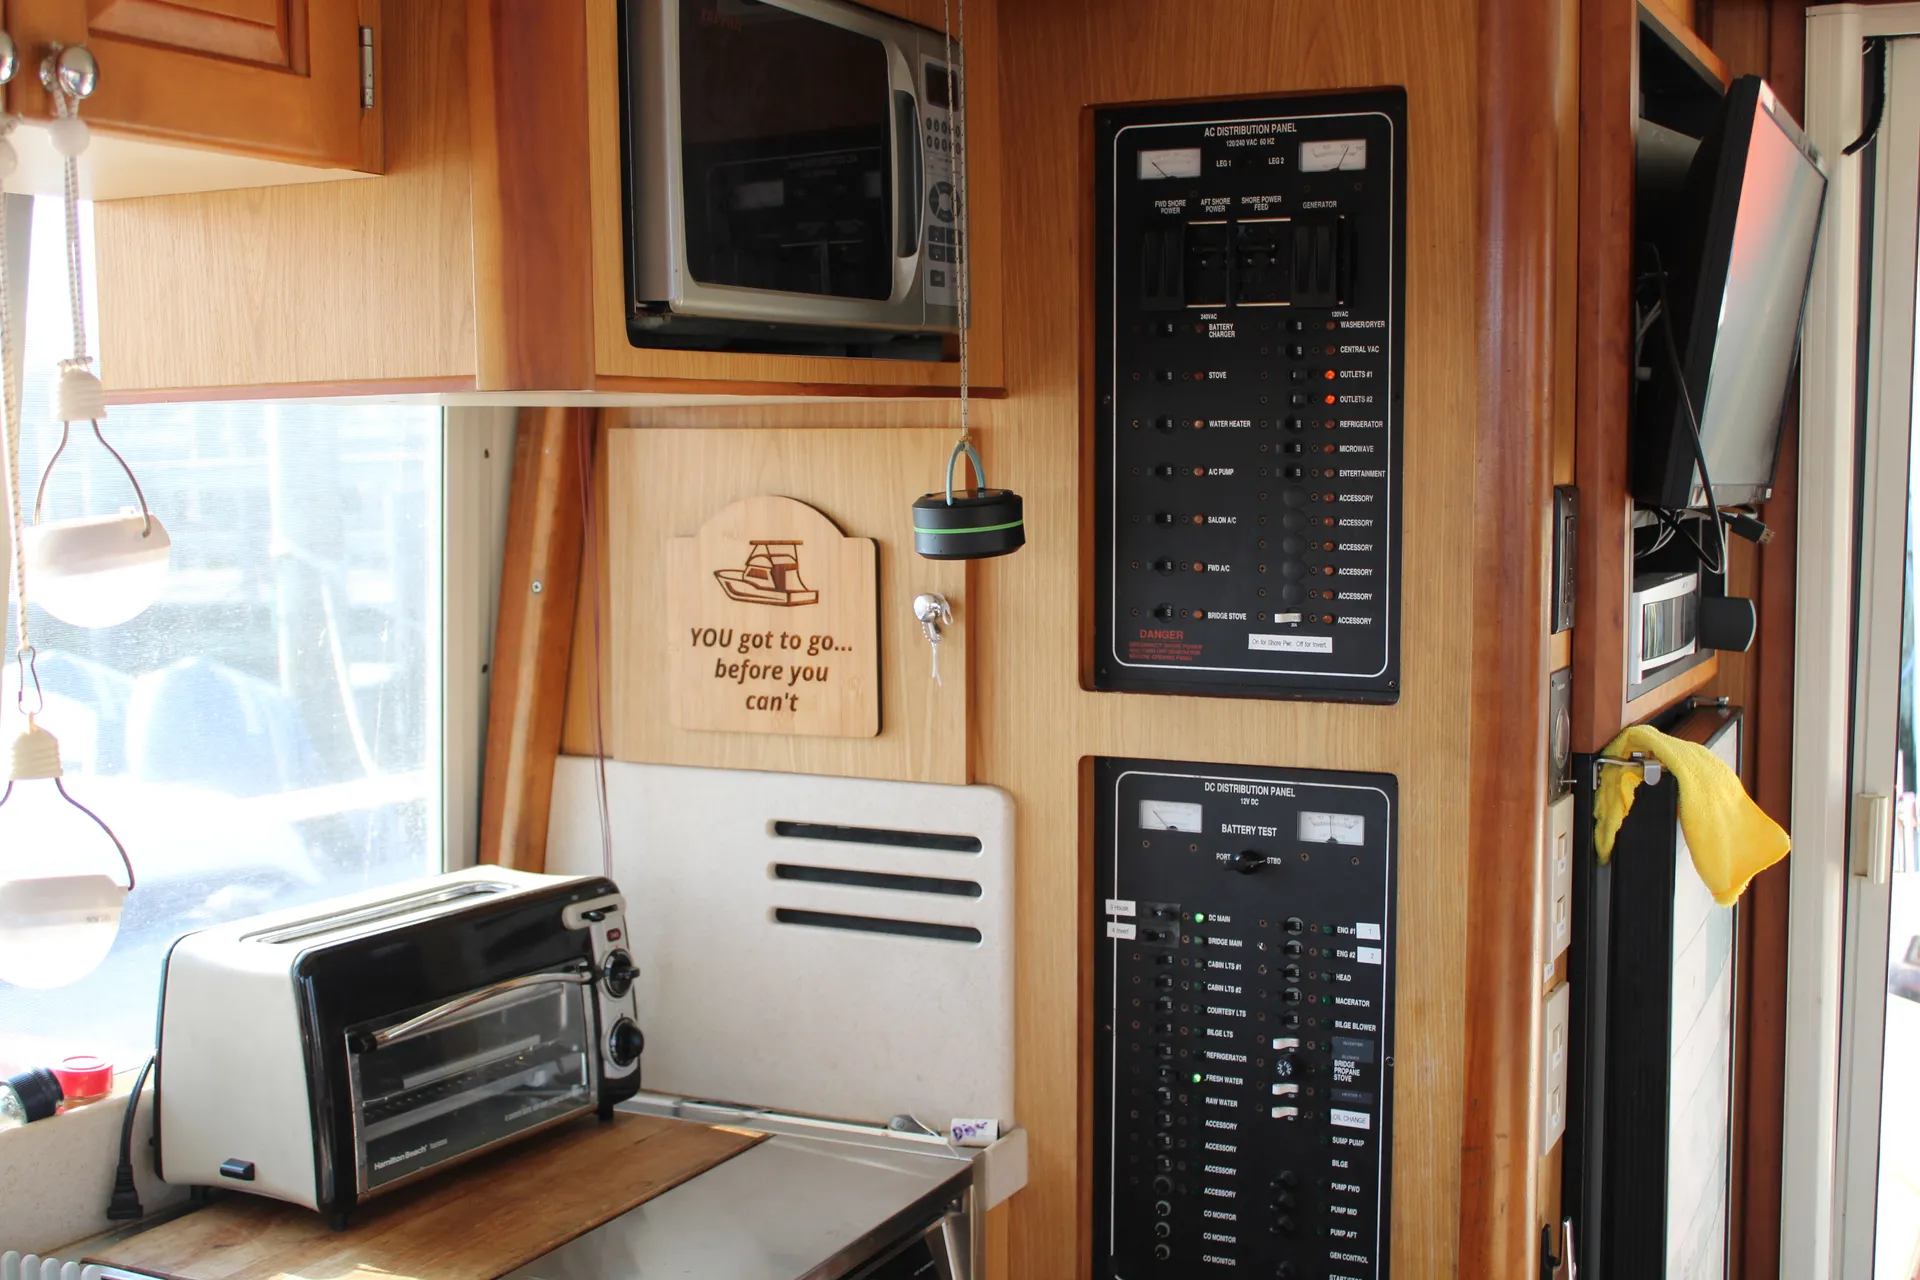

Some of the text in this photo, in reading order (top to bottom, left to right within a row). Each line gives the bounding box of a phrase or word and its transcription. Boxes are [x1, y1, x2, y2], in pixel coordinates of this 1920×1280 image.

[1204, 123, 1297, 137] AC DISTRIBUTION PANEL
[1268, 157, 1279, 165] LEG
[1303, 201, 1337, 209] GENERATOR
[1209, 420, 1251, 428] WATER HEATER
[1218, 468, 1234, 476] PUMP
[1208, 516, 1236, 524] SALON A/C
[1208, 564, 1220, 572] FWD
[1338, 568, 1372, 576] ACCESSORY
[1208, 612, 1247, 620] BRIDGE STOVE
[1338, 617, 1372, 625] ACCESSORY
[1140, 629, 1184, 640] DANGER
[690, 628, 852, 656] YOU got to go...
[715, 658, 829, 687] before you
[746, 692, 799, 712] can't
[1205, 782, 1295, 797] DC DISTRIBUTION PANEL
[1251, 798, 1259, 806] DC
[1222, 824, 1277, 837] BATTERY TEST
[1266, 857, 1281, 865] STBD
[1208, 938, 1242, 947] BRIDGE MAIN
[1208, 961, 1224, 969] CABIN
[1225, 962, 1235, 970] LTS
[1207, 984, 1224, 992] CABIN
[1225, 985, 1234, 993] LTS
[1335, 997, 1370, 1007] MACERATOR
[1207, 1006, 1246, 1017] COURTESY LTS
[1335, 1021, 1376, 1031] BILGE BLOWER
[1207, 1029, 1233, 1038] BILGE LTS
[1206, 1052, 1247, 1062] REFRIGERATOR
[1334, 1059, 1355, 1068] BRIDGE
[1334, 1067, 1360, 1076] PROPANE
[1206, 1074, 1243, 1085] FRESH WATER
[1334, 1074, 1352, 1082] STOVE
[1206, 1097, 1238, 1107] RAW WATER
[1333, 1113, 1366, 1124] OIL CHANGE
[1205, 1120, 1237, 1130] ACCESSORY
[1332, 1137, 1364, 1147] SUMP PUMP
[1205, 1142, 1237, 1153] ACCESSORY
[374, 1146, 426, 1170] Hamilton Beach
[1332, 1160, 1348, 1168] BILGE
[1204, 1165, 1237, 1175] ACCESSORY
[1331, 1182, 1360, 1193] PUMP FWD
[1204, 1188, 1236, 1198] ACCESSORY
[1204, 1210, 1236, 1221] CO MONITOR
[1331, 1206, 1357, 1215] PUMP MID
[1212, 1234, 1236, 1243] MONITOR
[1330, 1228, 1357, 1239] PUMP AFT
[1212, 1256, 1236, 1266] MONITOR
[1330, 1252, 1368, 1264] GEN CONTROL
